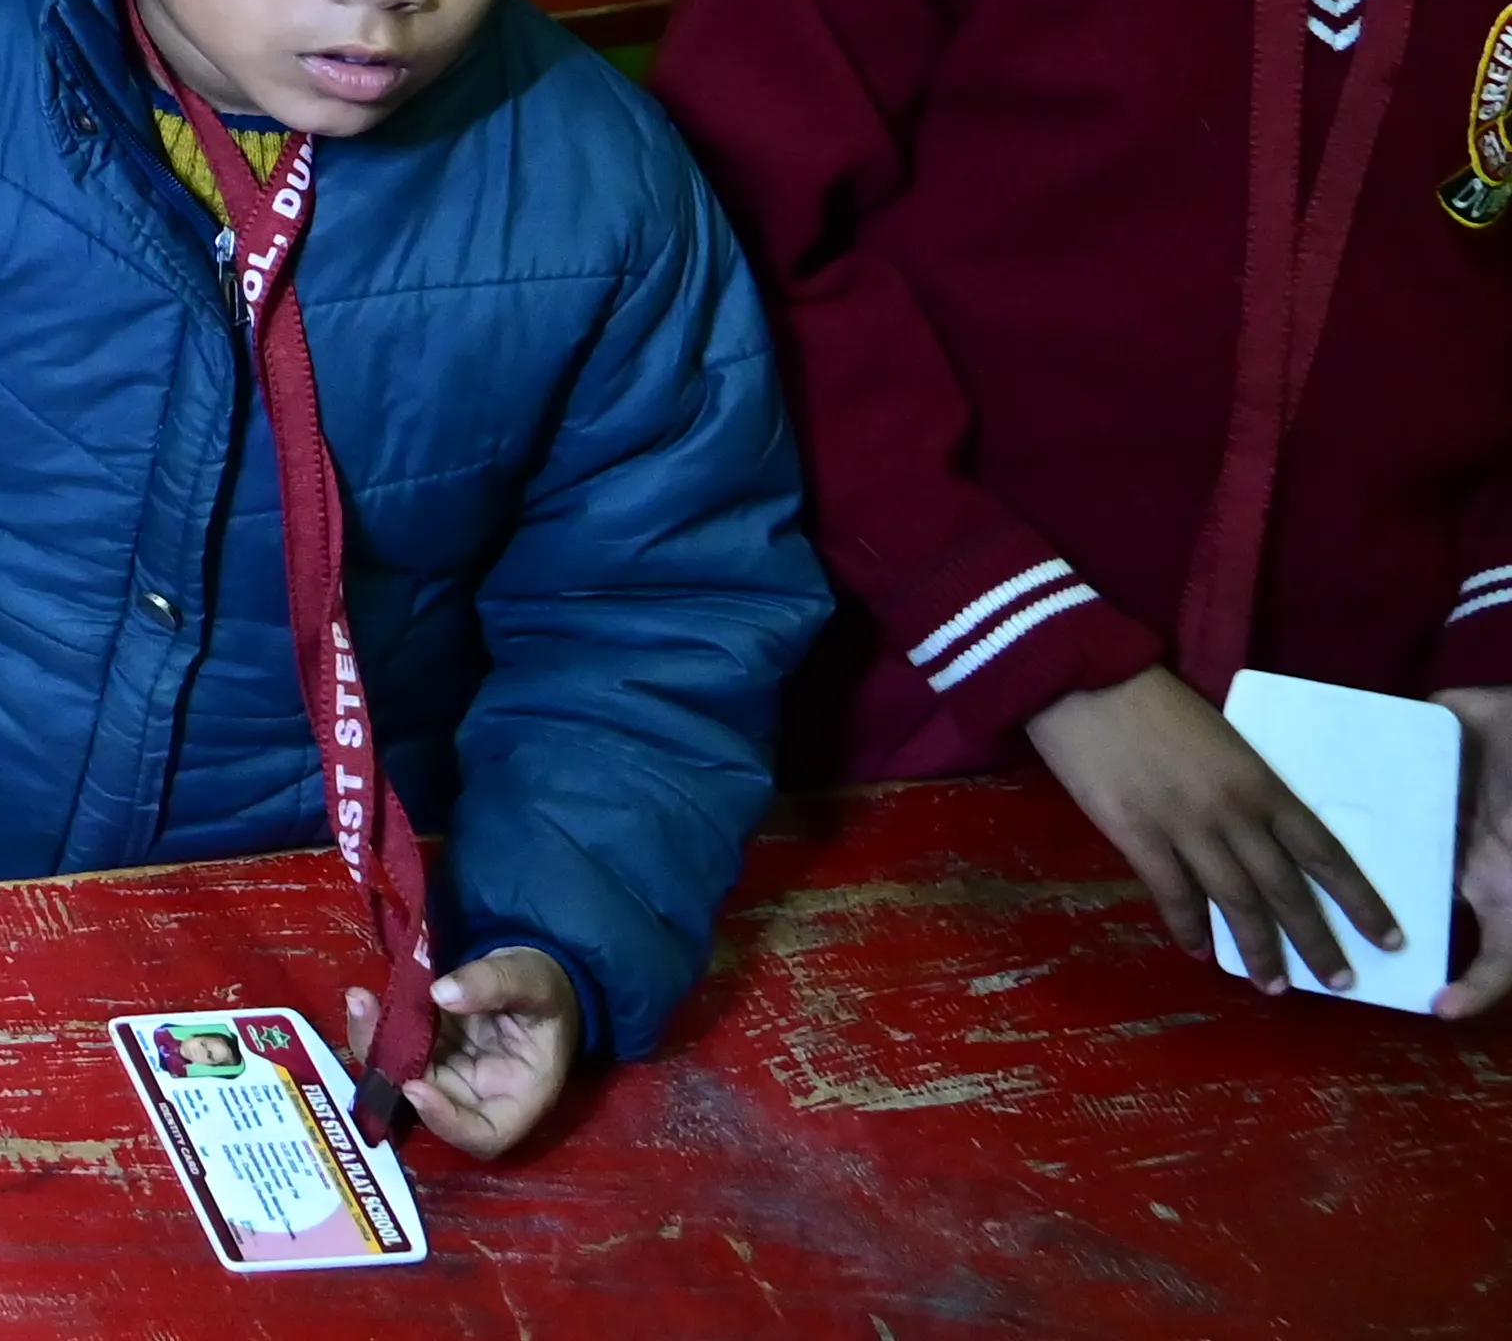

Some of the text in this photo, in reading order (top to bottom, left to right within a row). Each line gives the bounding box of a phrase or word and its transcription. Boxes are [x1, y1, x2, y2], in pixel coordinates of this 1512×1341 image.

[300, 1085, 336, 1118] FIRST
[157, 1104, 201, 1174] IDENTITY CARD
[320, 1121, 352, 1149] STEP
[336, 1151, 357, 1159] A
[342, 1163, 376, 1195] PLAY
[360, 1196, 403, 1244] SCHOOL
